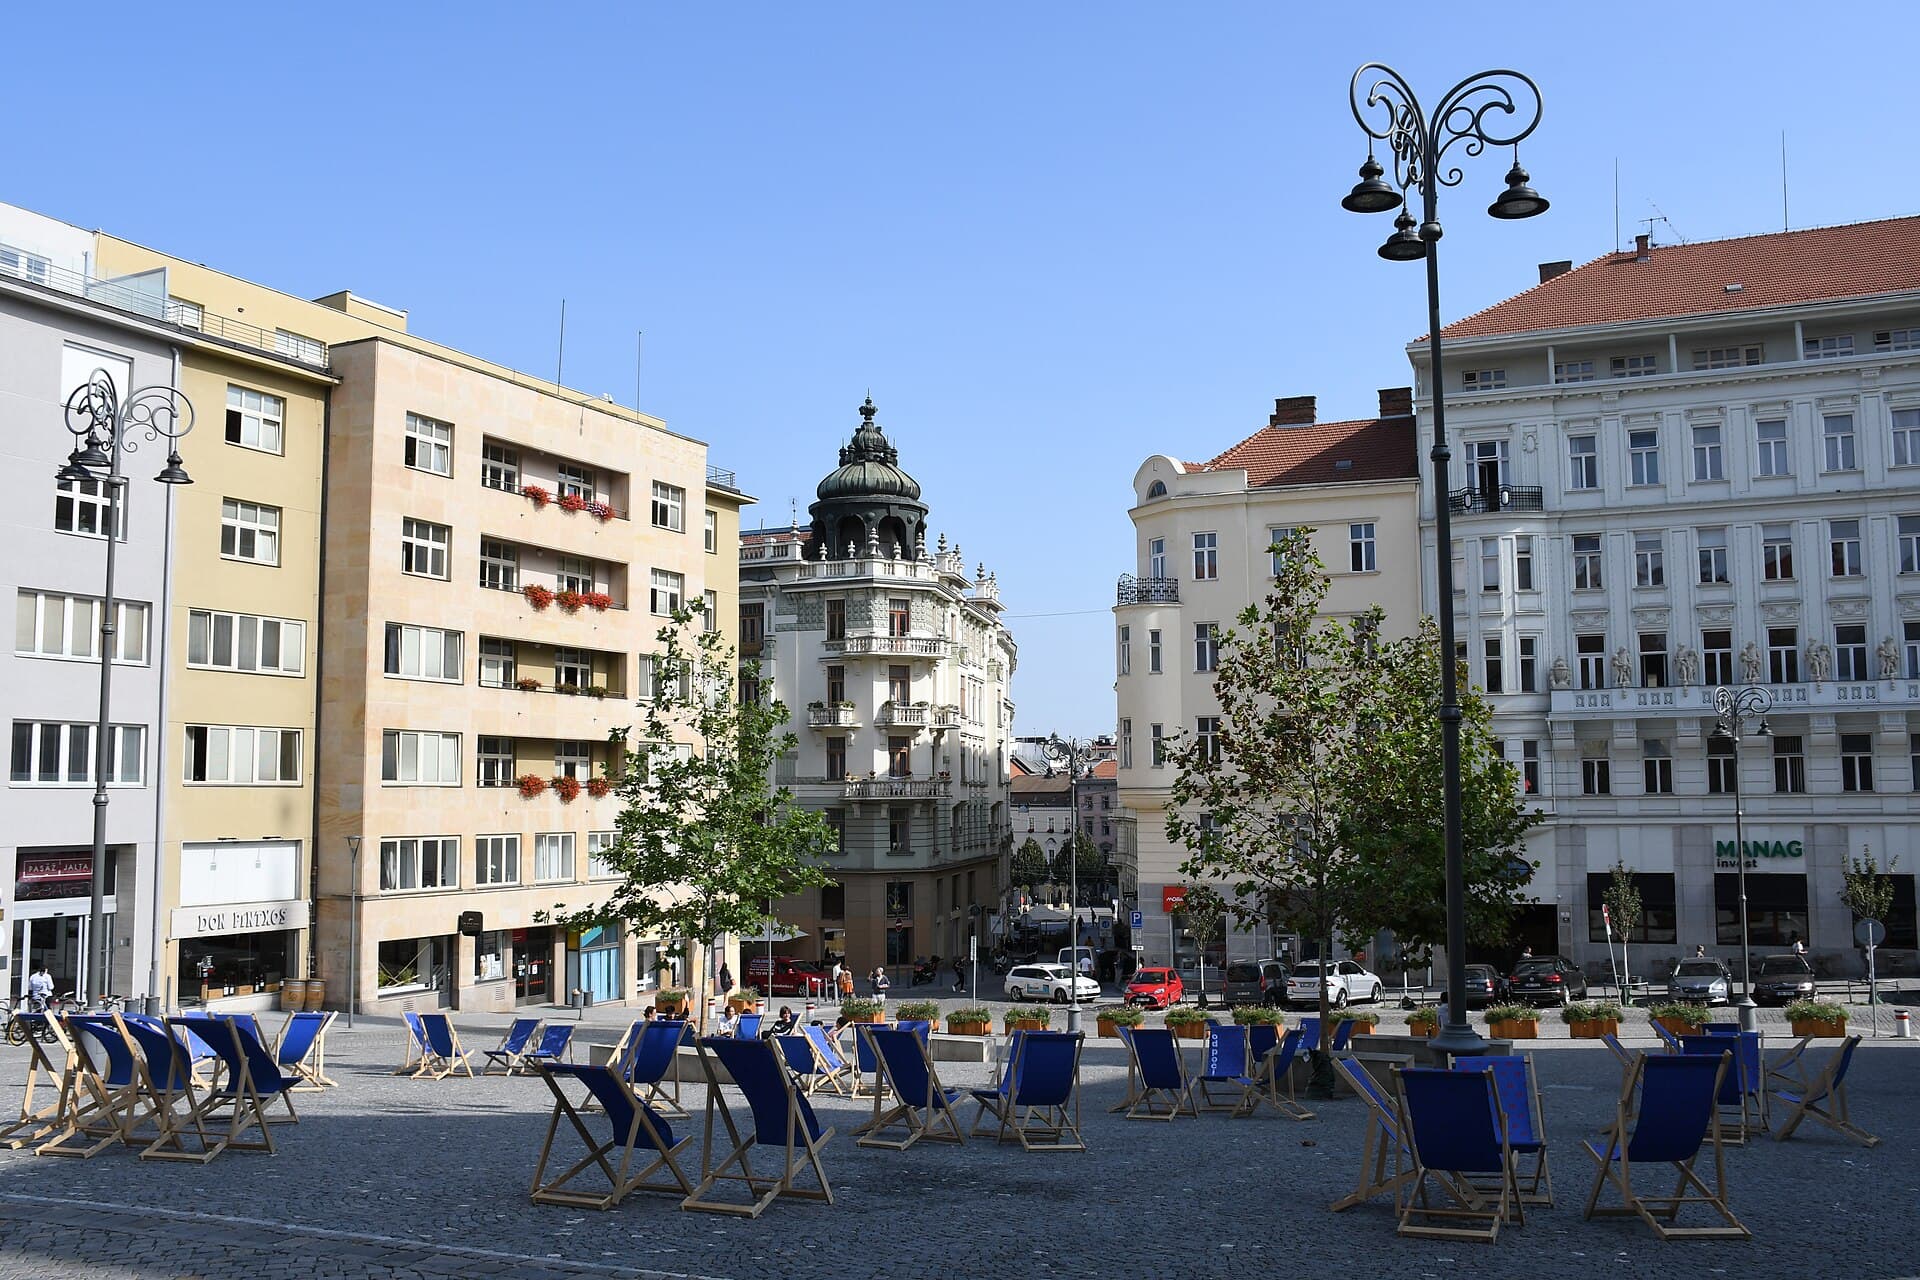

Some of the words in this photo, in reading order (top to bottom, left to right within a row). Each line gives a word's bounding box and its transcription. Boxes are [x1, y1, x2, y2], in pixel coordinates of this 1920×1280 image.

[1716, 840, 1802, 858] MANAG
[63, 863, 89, 872] JALTA
[197, 913, 225, 932] DON
[232, 908, 288, 929] PINTXOS
[1133, 913, 1141, 923] P
